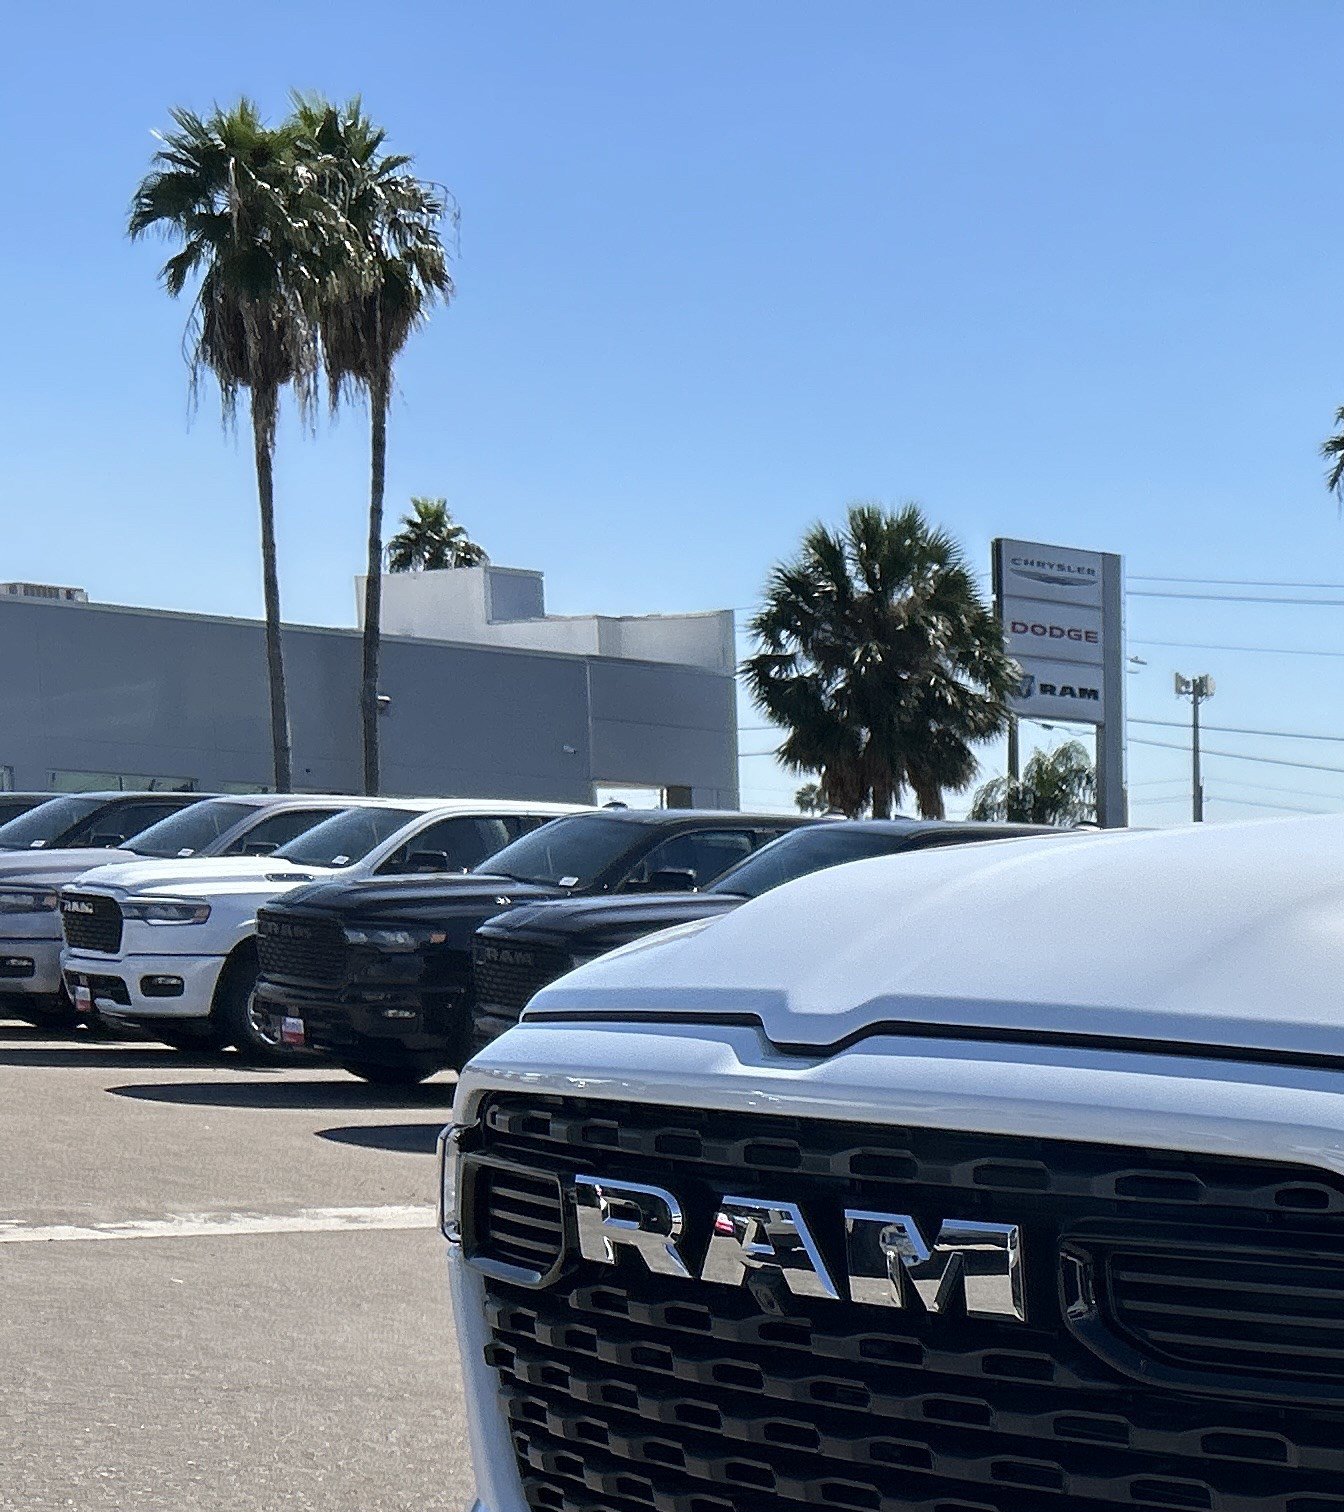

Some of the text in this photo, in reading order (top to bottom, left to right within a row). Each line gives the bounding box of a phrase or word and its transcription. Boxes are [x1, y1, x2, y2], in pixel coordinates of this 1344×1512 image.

[1011, 557, 1096, 576] CHRYSLER
[1011, 621, 1098, 643] DODGE
[1039, 683, 1099, 701] RAM
[575, 1174, 1026, 1322] RAM
